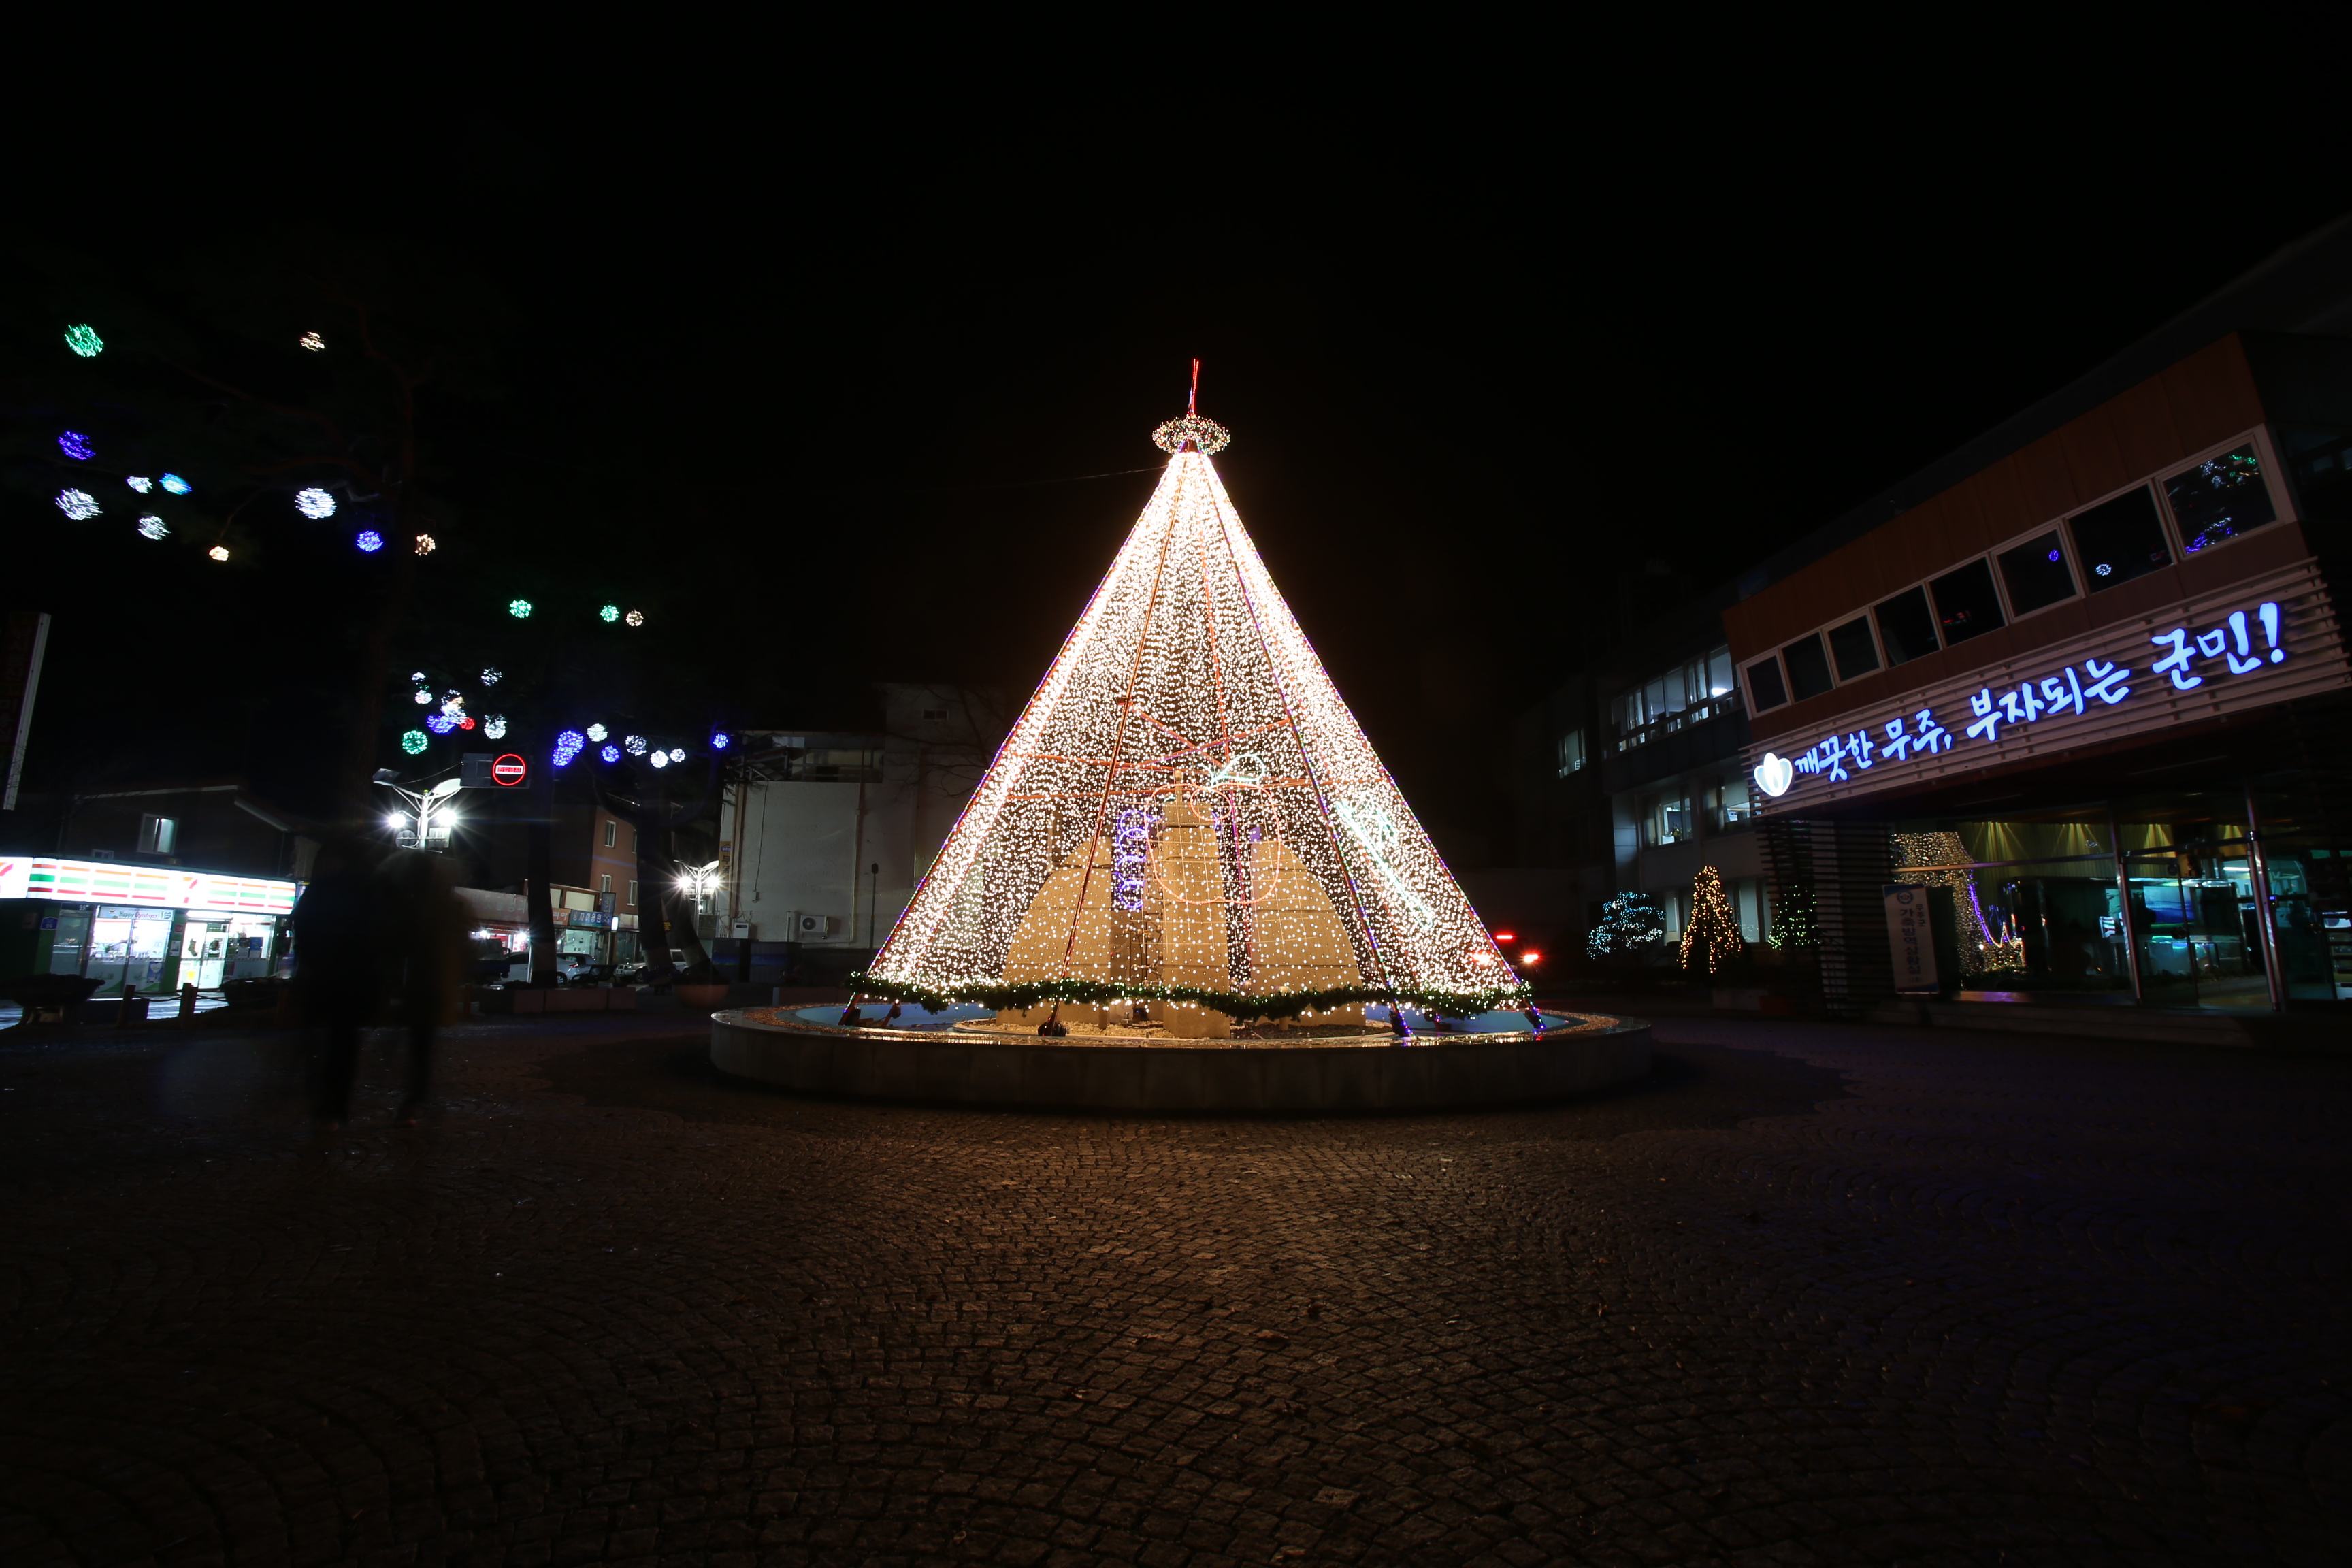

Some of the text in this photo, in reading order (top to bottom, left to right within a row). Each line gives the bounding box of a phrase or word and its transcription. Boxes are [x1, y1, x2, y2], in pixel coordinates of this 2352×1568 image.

[1795, 602, 2285, 782] 깨끗한 무주, 부자되는 군민!
[1916, 904, 1926, 927] 무주군
